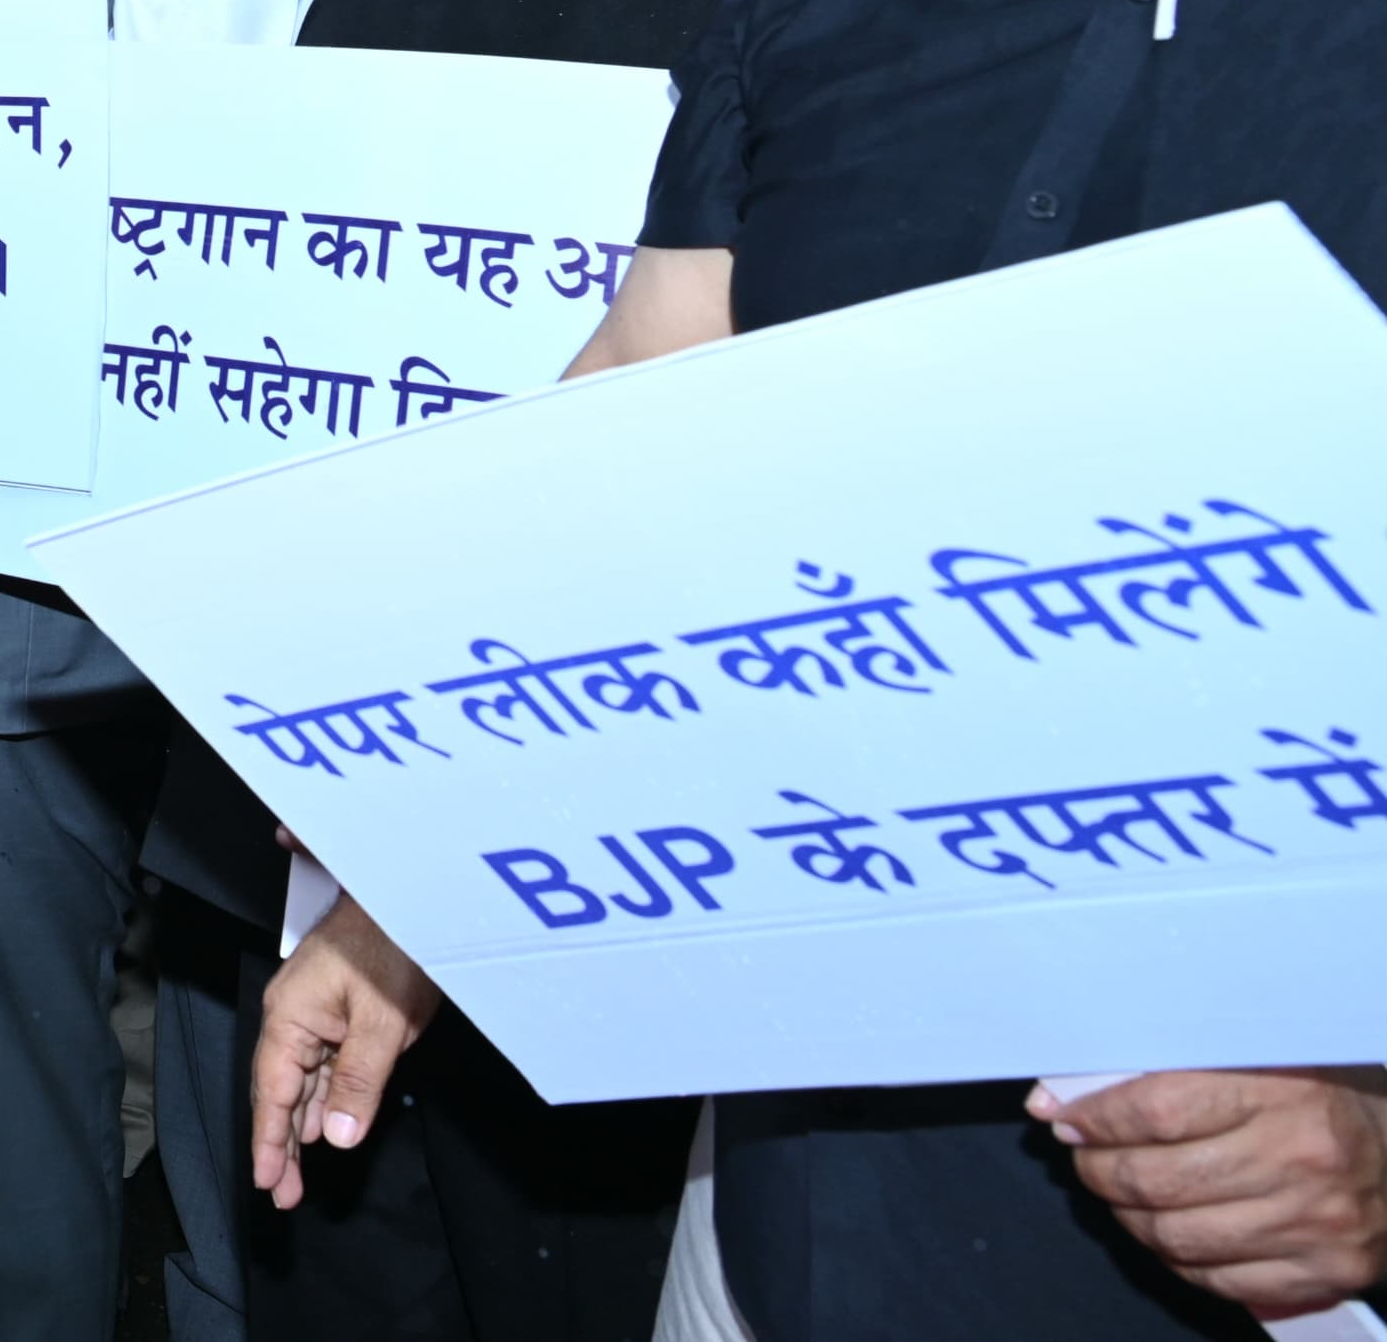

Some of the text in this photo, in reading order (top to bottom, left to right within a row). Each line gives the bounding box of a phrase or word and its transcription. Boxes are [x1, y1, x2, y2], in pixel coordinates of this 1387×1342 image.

[110, 197, 288, 280] ष्ट्रगान
[302, 213, 403, 282] का
[417, 223, 534, 308] यह
[102, 325, 190, 420] नहीं
[204, 336, 374, 439] सहेगा
[225, 500, 1373, 776] पेपर लीक कहाँ मिलेंगे
[482, 827, 734, 929] BJP
[752, 791, 915, 892] के
[897, 775, 1274, 888] दफ्तर
